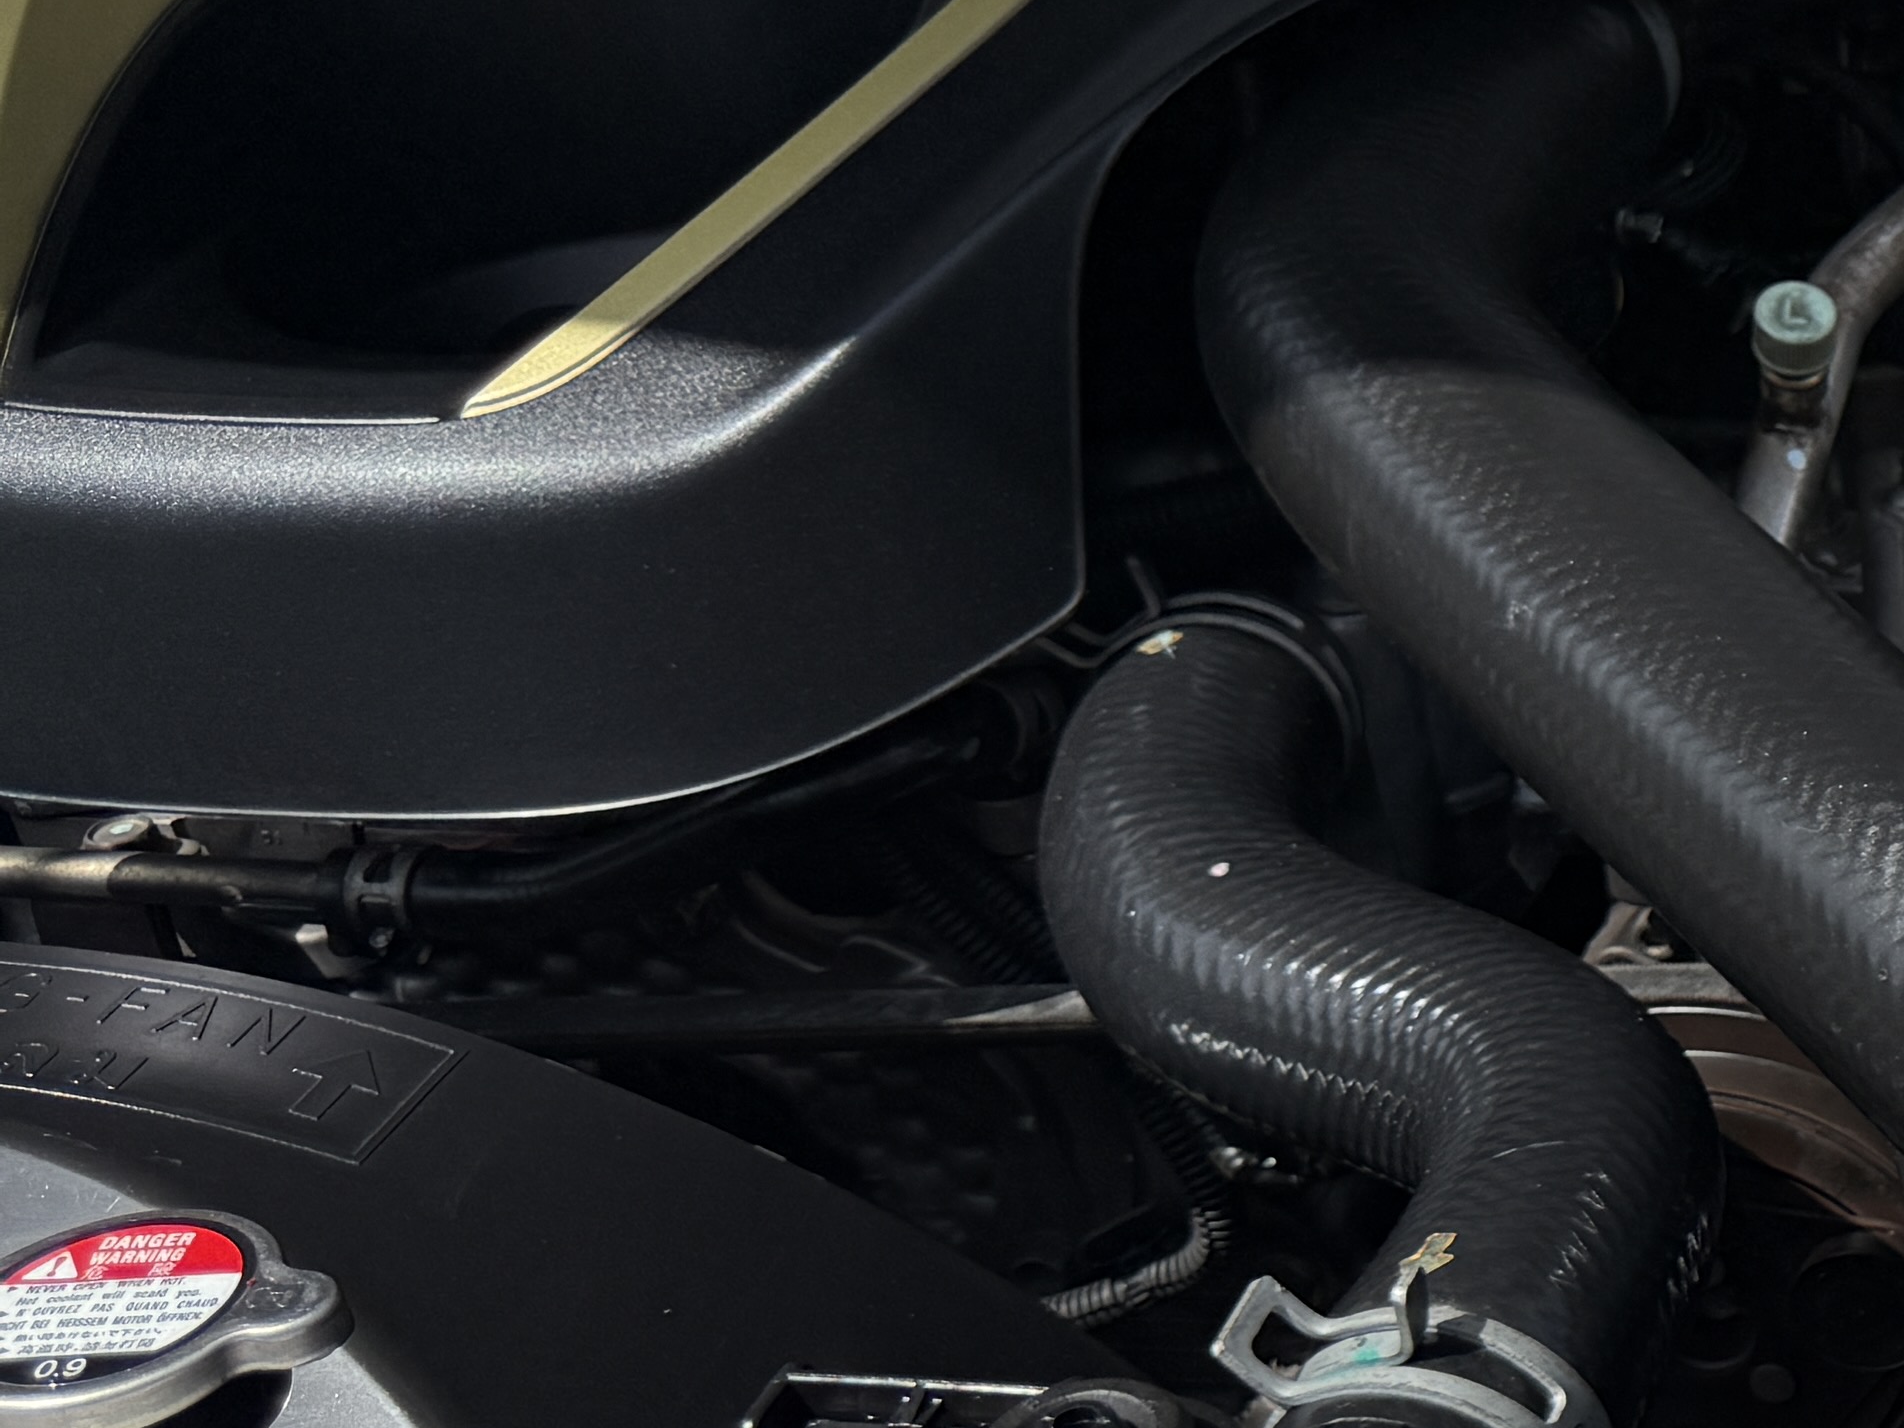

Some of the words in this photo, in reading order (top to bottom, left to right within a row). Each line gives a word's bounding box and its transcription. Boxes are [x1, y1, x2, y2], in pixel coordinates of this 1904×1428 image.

[99, 1232, 198, 1250] DANGER
[90, 1248, 187, 1265] WARNING
[91, 1303, 116, 1313] PAS
[112, 1314, 153, 1326] MOTOR
[34, 1358, 87, 1379] 0.9
